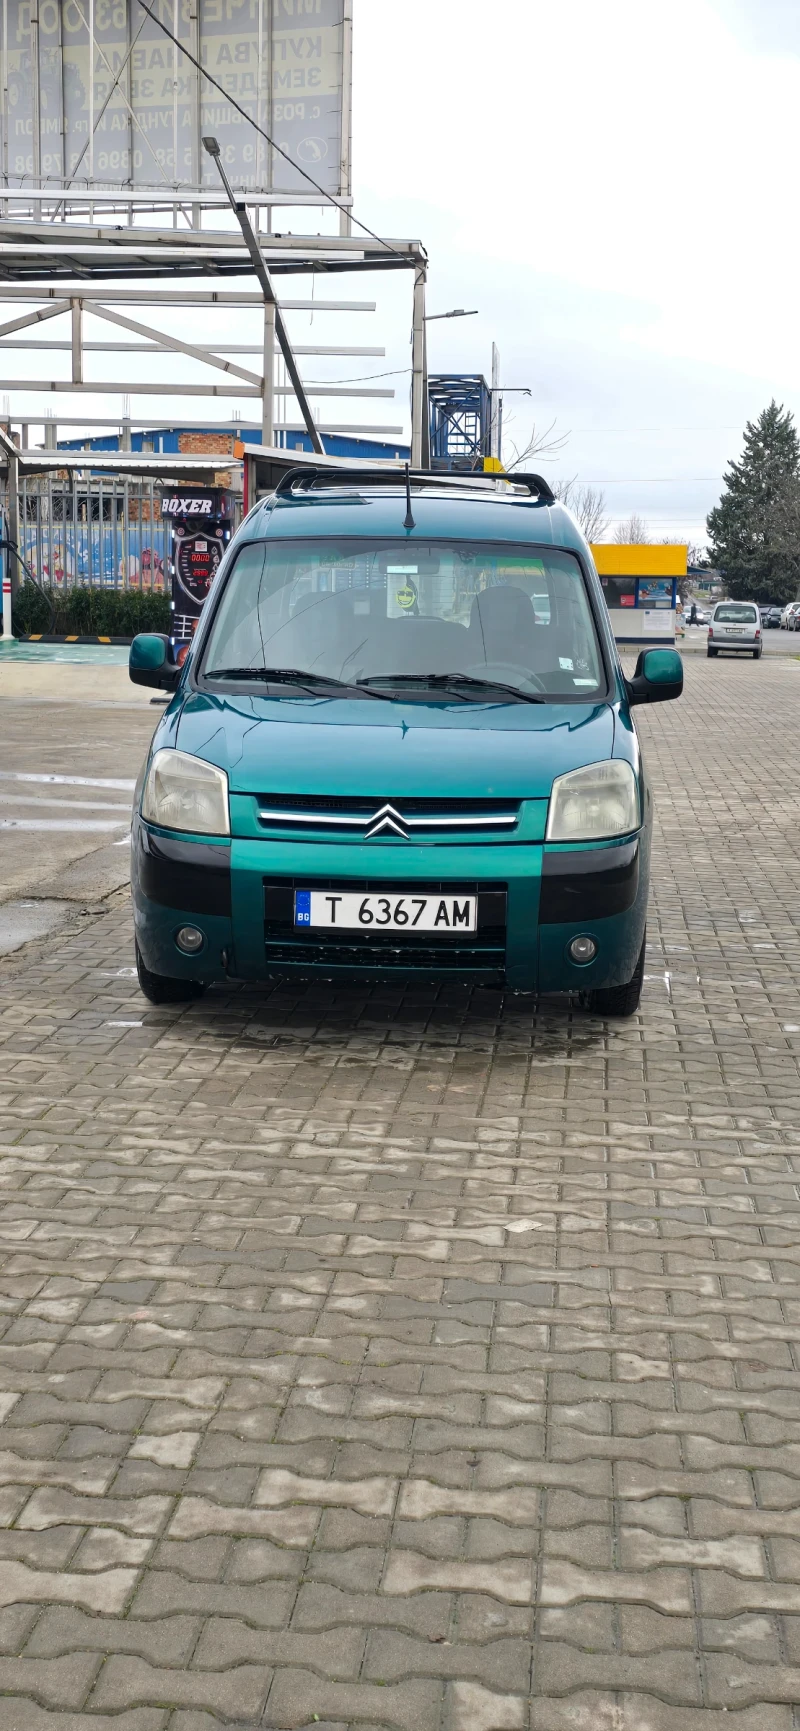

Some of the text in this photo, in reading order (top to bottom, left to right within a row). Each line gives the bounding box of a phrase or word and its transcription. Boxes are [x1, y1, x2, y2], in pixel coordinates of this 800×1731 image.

[161, 498, 212, 514] BOXER
[297, 896, 471, 927] BG T 6367 AM
